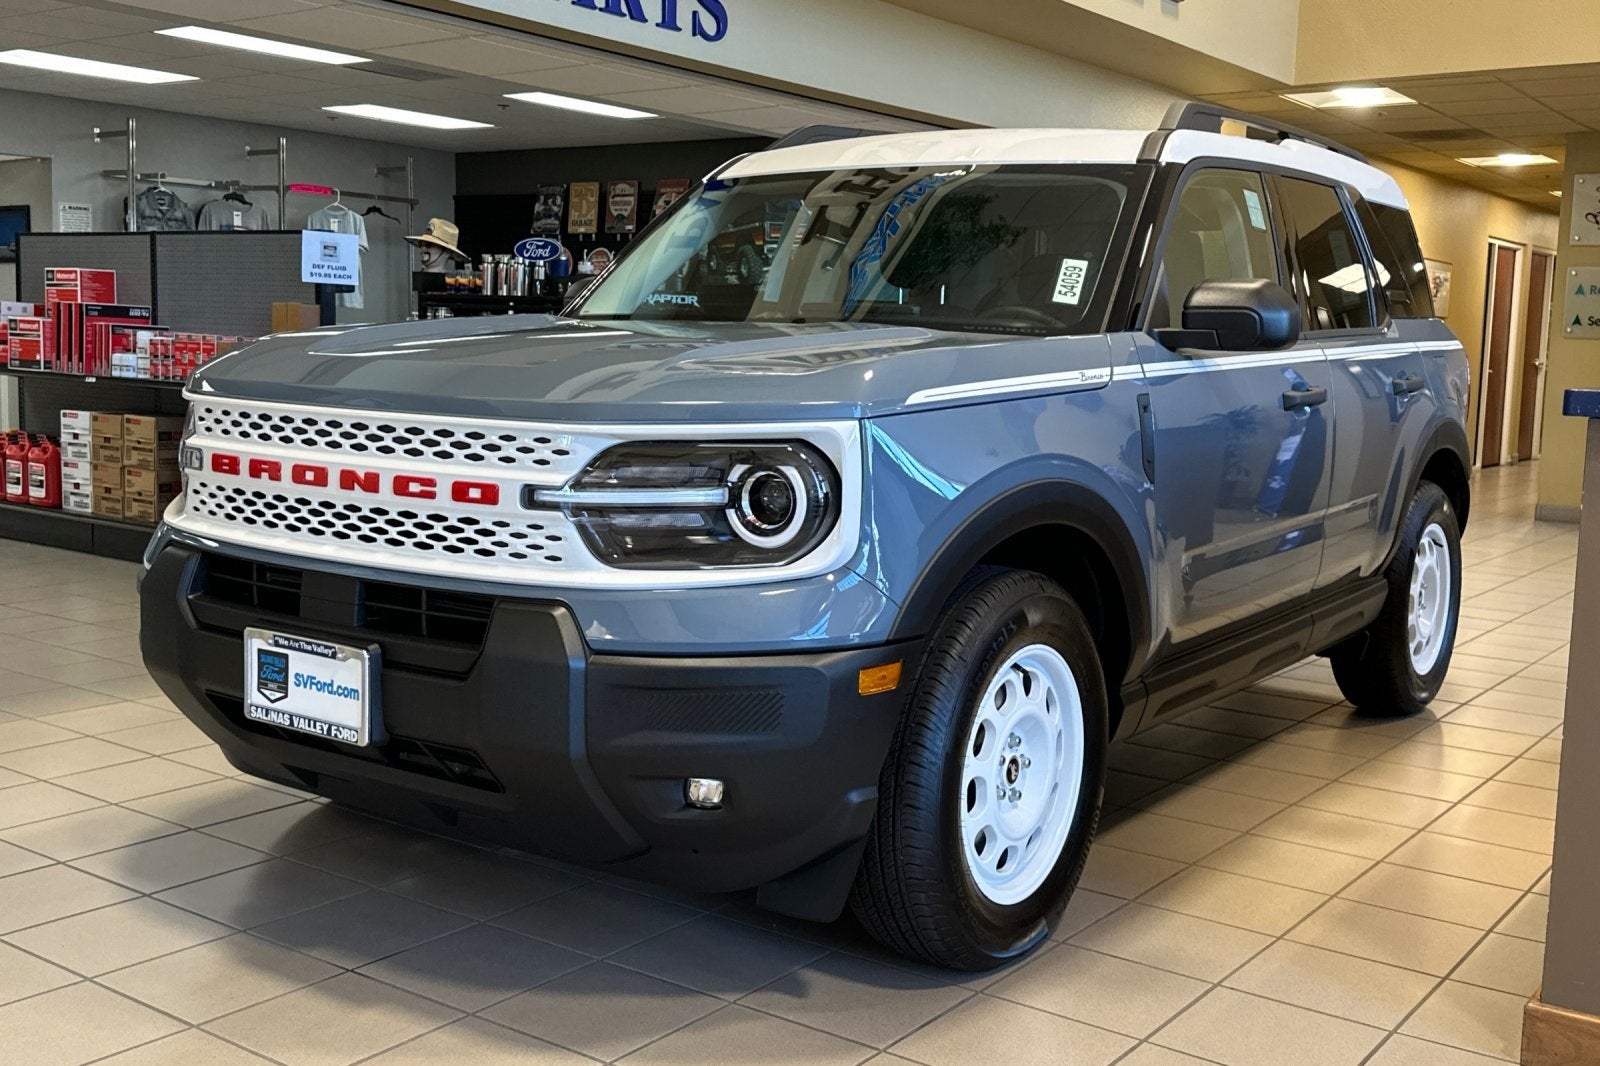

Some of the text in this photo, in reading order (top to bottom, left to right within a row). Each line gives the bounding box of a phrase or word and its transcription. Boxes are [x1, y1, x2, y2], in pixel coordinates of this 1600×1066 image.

[523, 240, 551, 258] Ford
[1058, 265, 1083, 298] 54059
[643, 293, 700, 307] RAPTOR
[211, 452, 500, 506] BRONCO
[299, 641, 313, 651] The
[260, 664, 285, 682] Ford
[294, 672, 360, 701] SVFord.com
[250, 705, 358, 743] SALINAS VALLEY FORD
